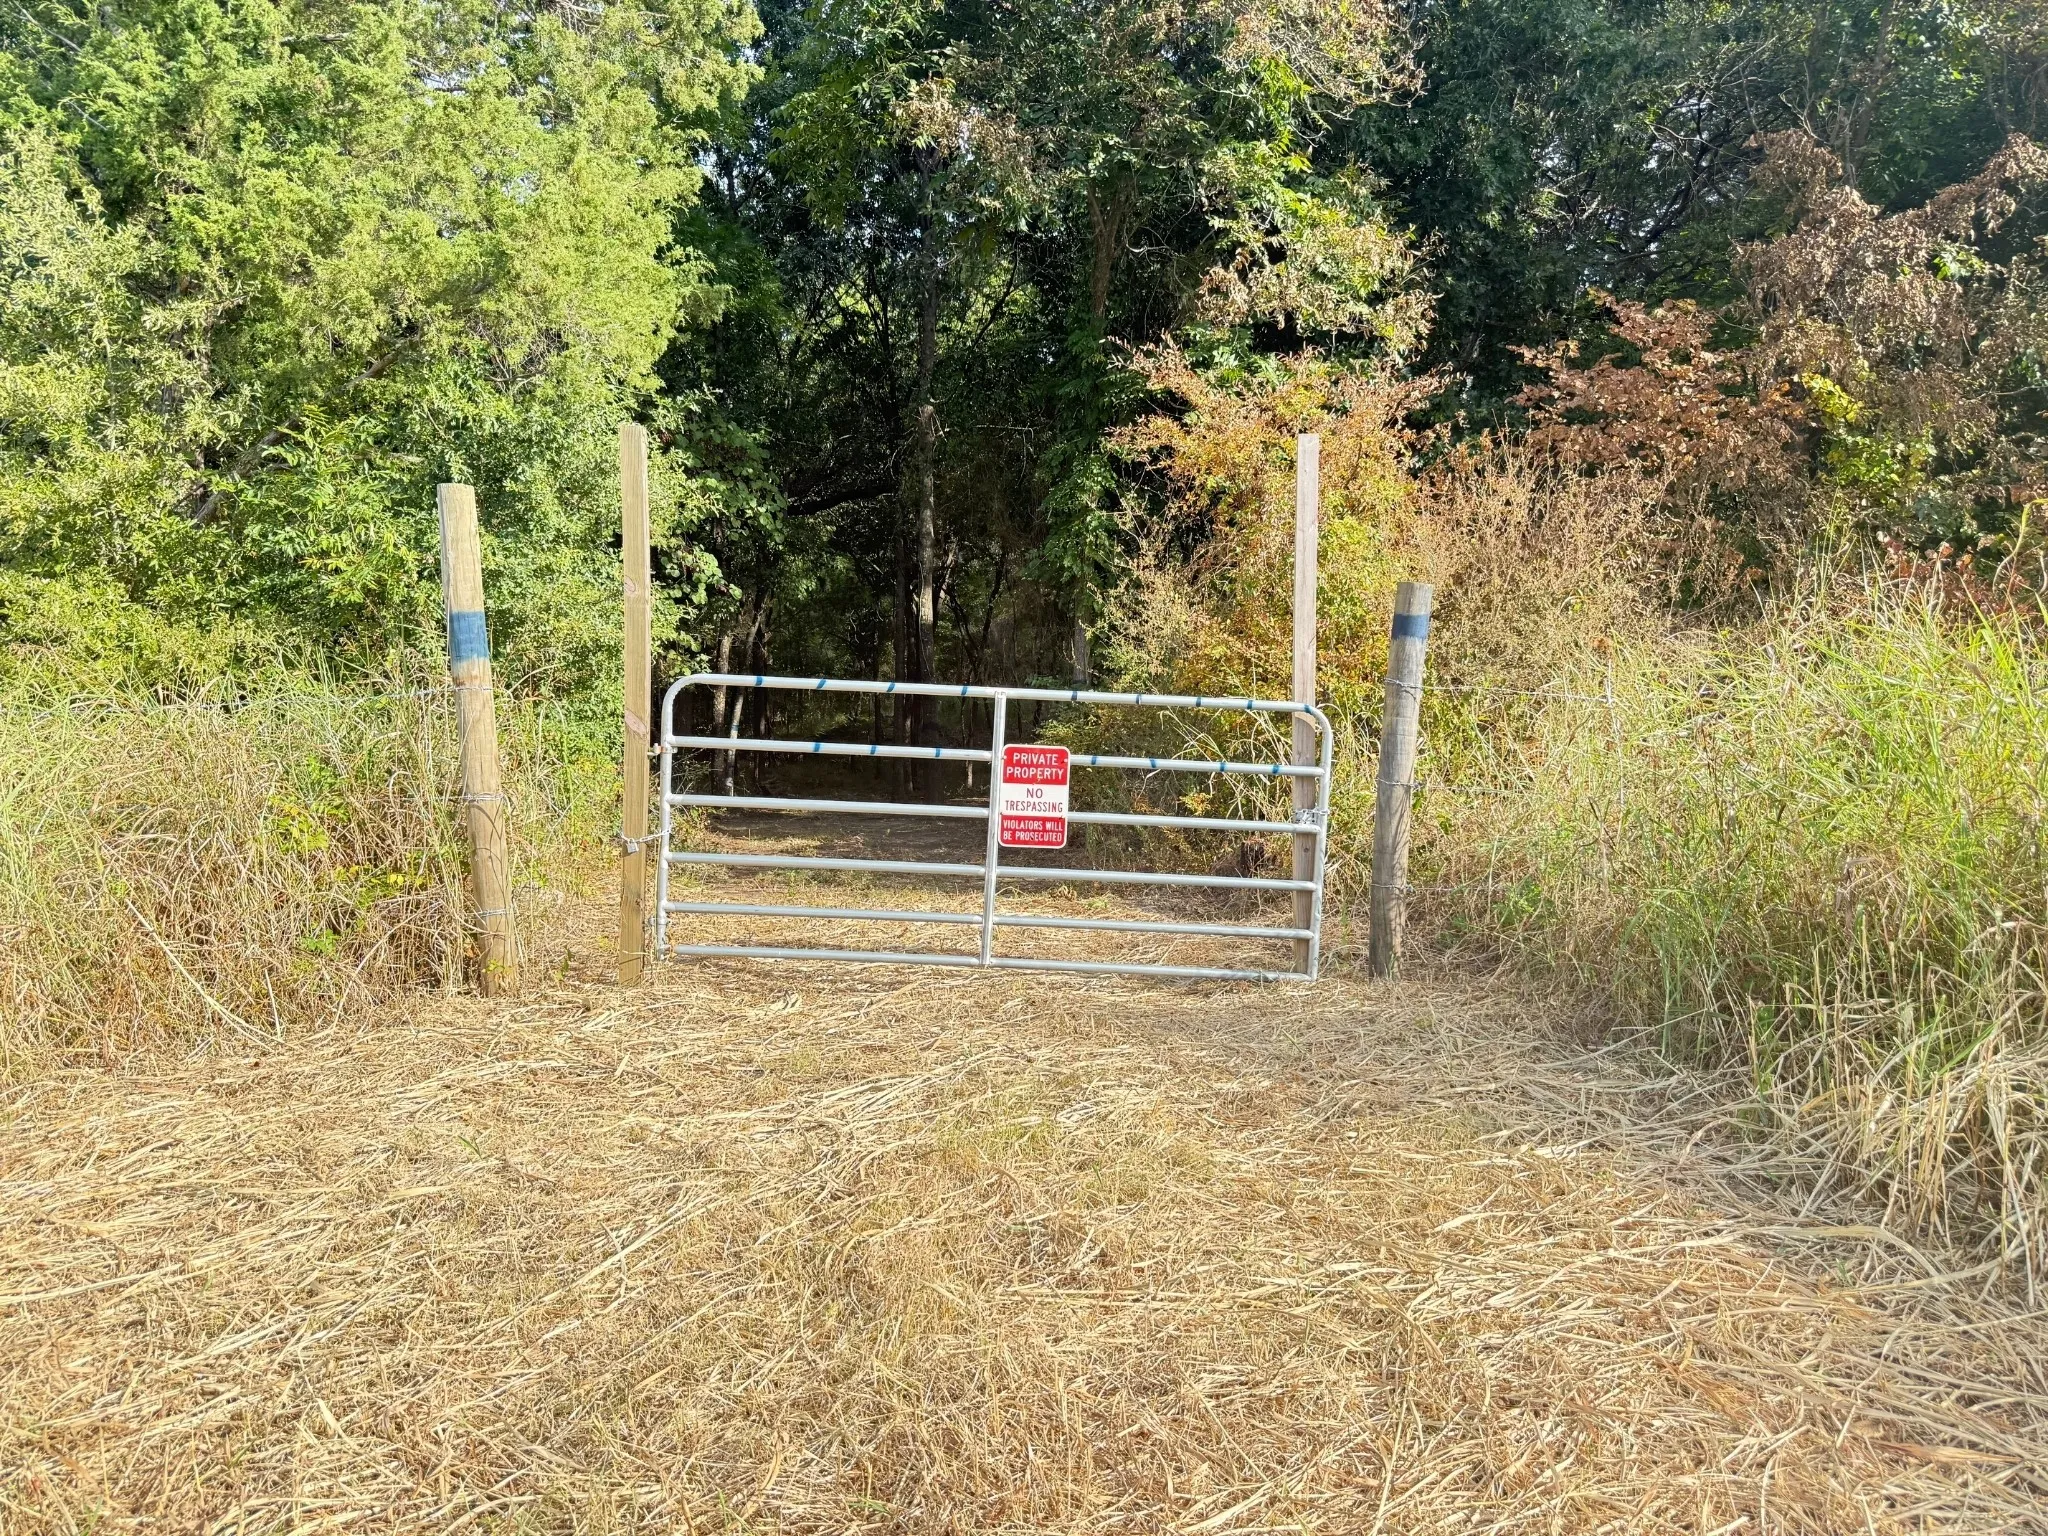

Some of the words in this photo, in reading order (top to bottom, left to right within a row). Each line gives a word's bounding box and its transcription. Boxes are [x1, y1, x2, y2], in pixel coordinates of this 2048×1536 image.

[1013, 752, 1058, 766] PRIVATE
[1006, 766, 1064, 780] PROPERTY
[1026, 788, 1043, 799] NO
[1005, 800, 1063, 813] TRESPASSING
[1003, 819, 1043, 830] VIOLATORS
[1045, 821, 1063, 831] WILL
[1003, 831, 1012, 840] BE
[1015, 831, 1062, 842] PROSECUTED
